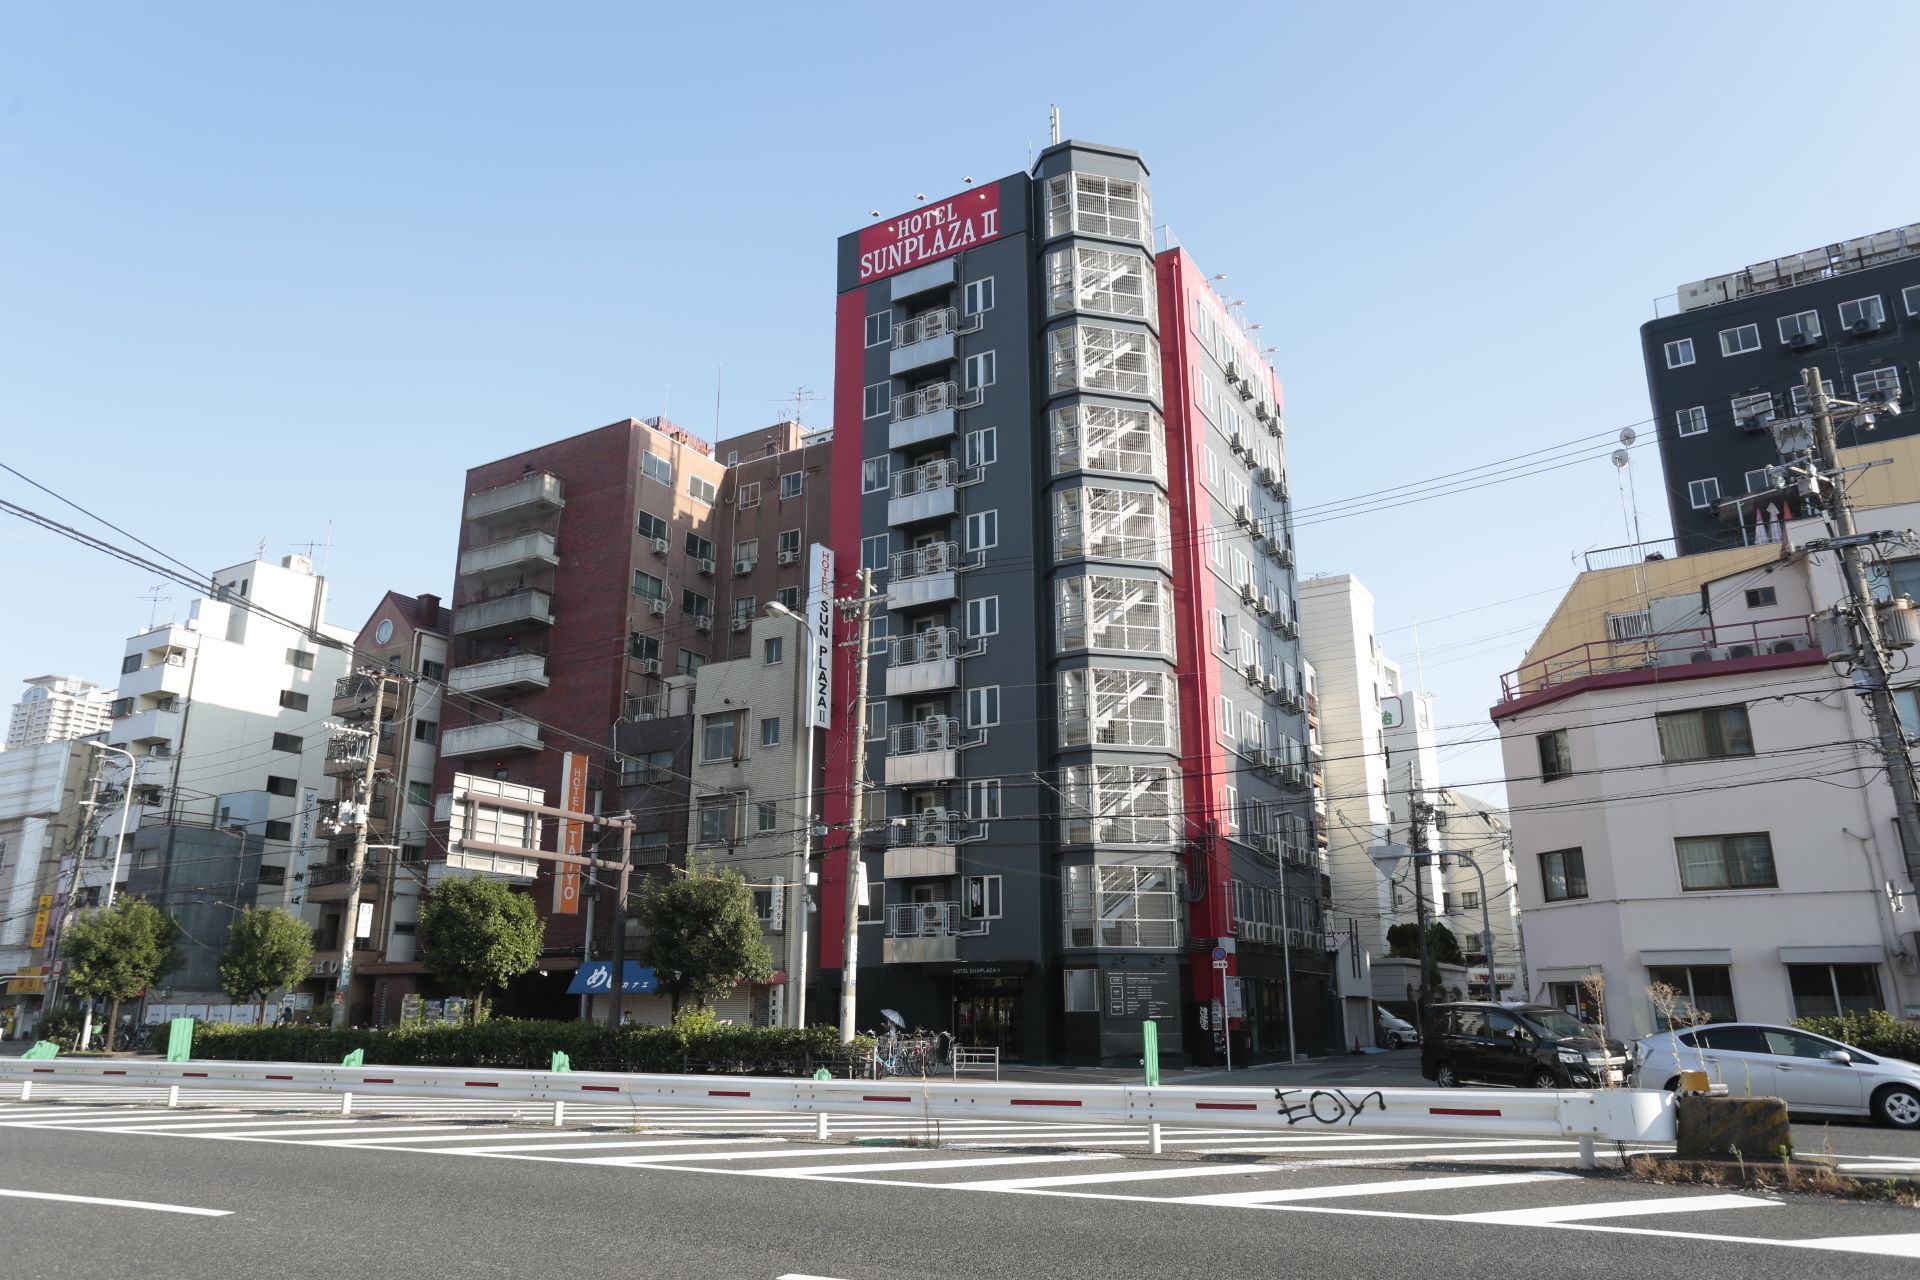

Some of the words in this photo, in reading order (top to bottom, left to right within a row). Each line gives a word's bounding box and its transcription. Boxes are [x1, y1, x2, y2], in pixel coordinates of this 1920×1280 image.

[897, 203, 958, 239] HOTEL
[860, 217, 977, 279] SUNPLAZA
[821, 551, 830, 595] HOTEL
